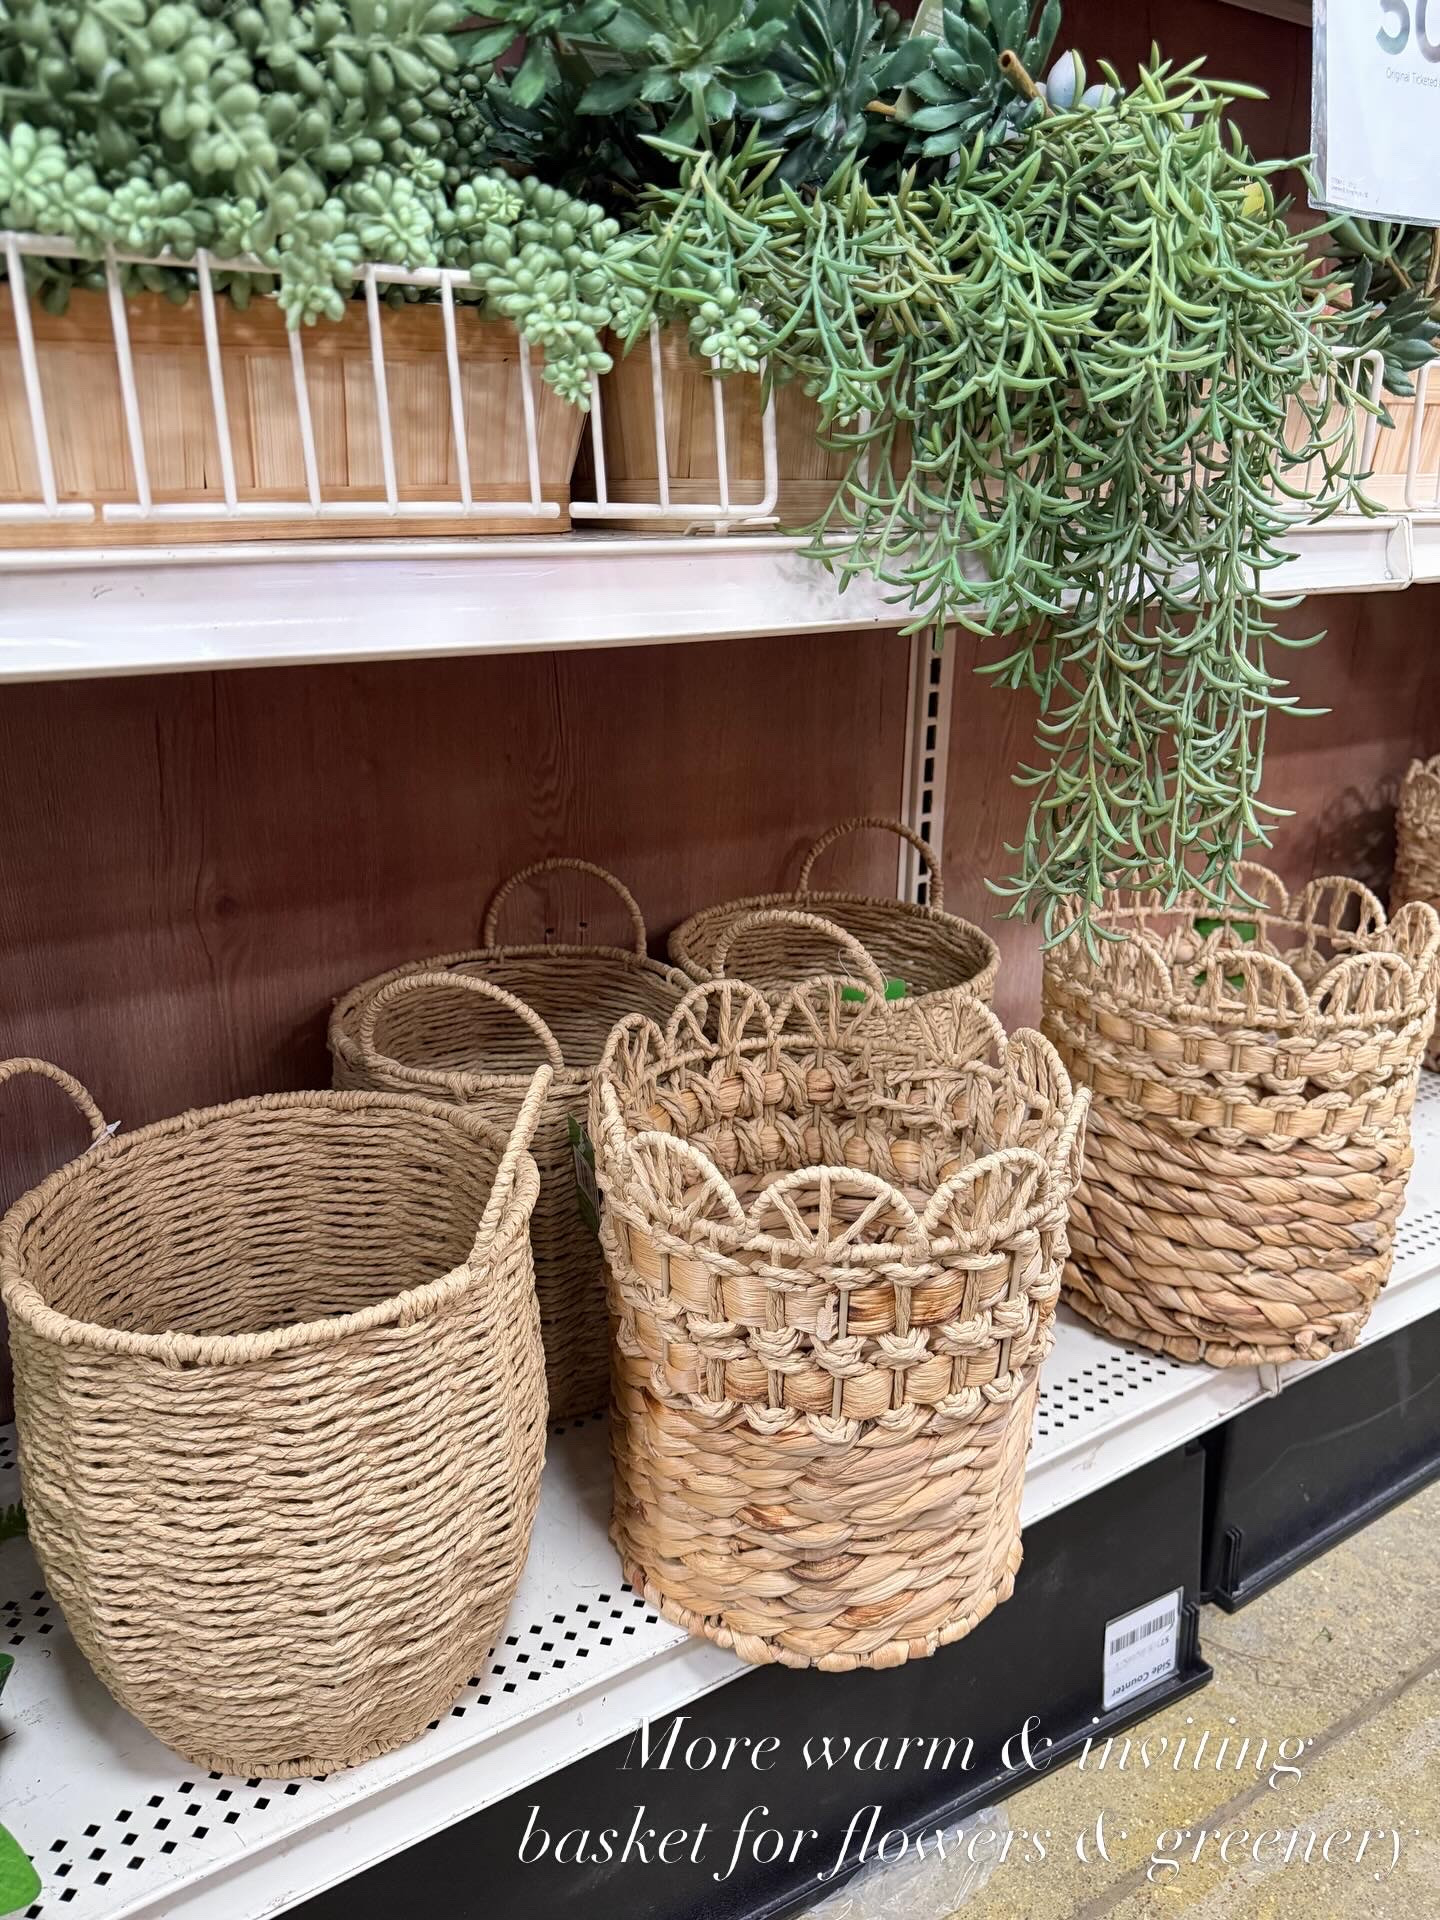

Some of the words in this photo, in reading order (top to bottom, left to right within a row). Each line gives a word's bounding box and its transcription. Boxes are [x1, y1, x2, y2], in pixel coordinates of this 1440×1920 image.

[1386, 66, 1410, 83] Original
[1412, 71, 1438, 88] Ticketed
[1152, 1659, 1172, 1674] Side
[1111, 1671, 1150, 1697] Counter
